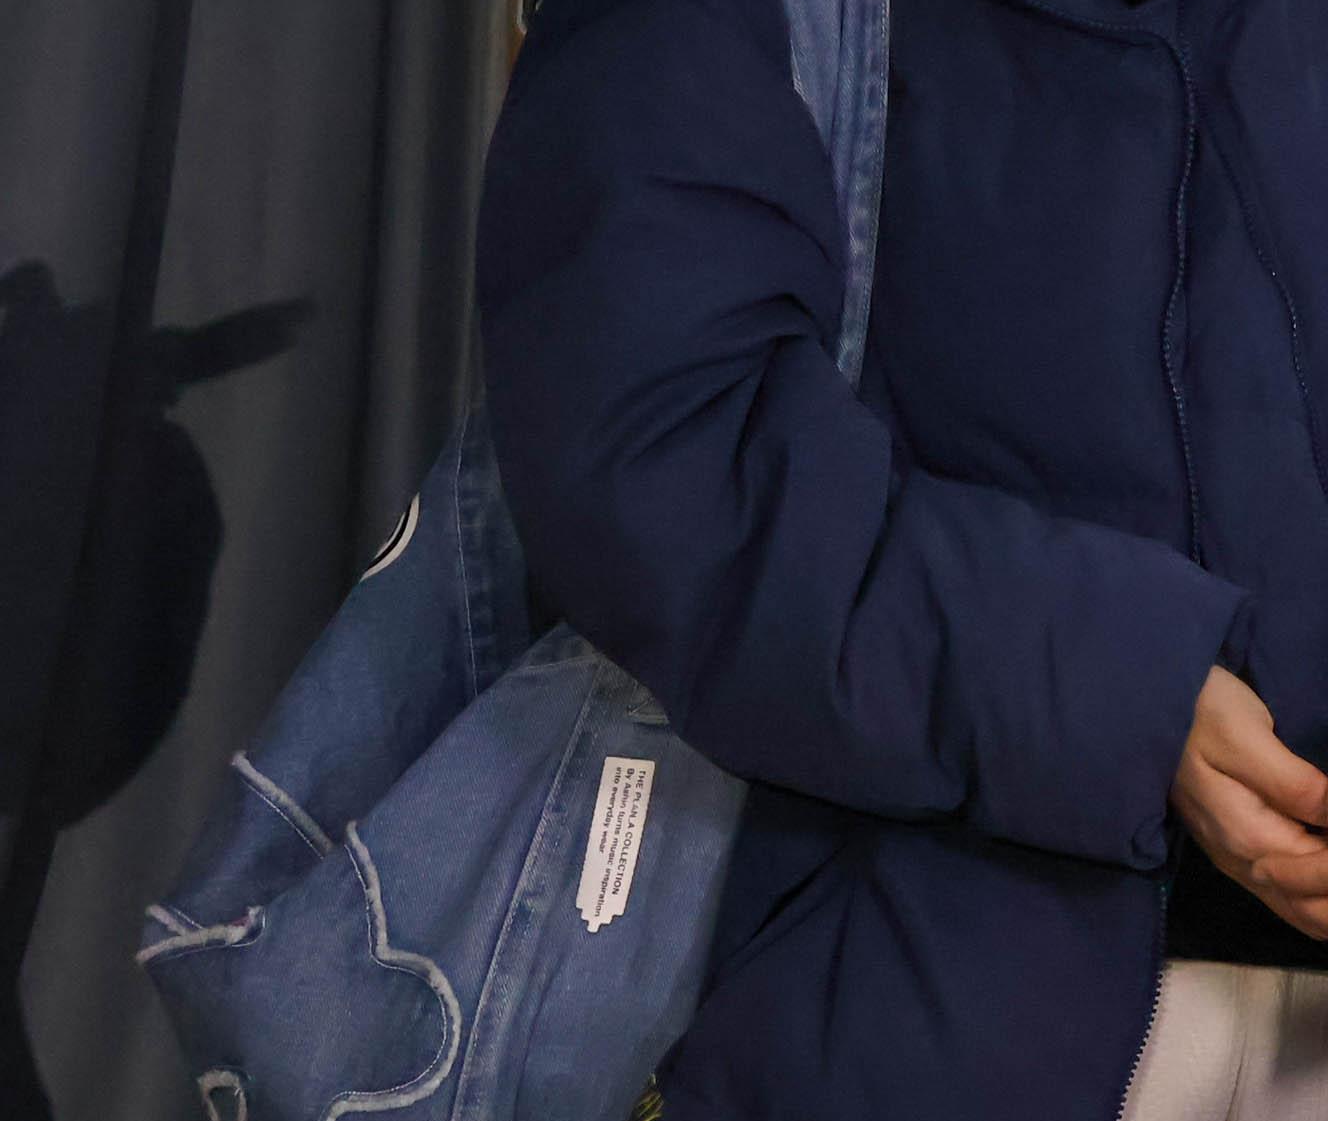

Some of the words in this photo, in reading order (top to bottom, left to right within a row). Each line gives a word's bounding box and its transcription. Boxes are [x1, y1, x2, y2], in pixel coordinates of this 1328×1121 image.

[613, 766, 623, 785] into
[624, 767, 635, 781] By
[635, 770, 646, 789] THE
[603, 786, 619, 828] everyday
[614, 811, 625, 835] turns
[598, 831, 609, 854] wear
[607, 837, 619, 865] music
[612, 831, 633, 896] COLLECTION
[594, 867, 611, 918] inspiration
